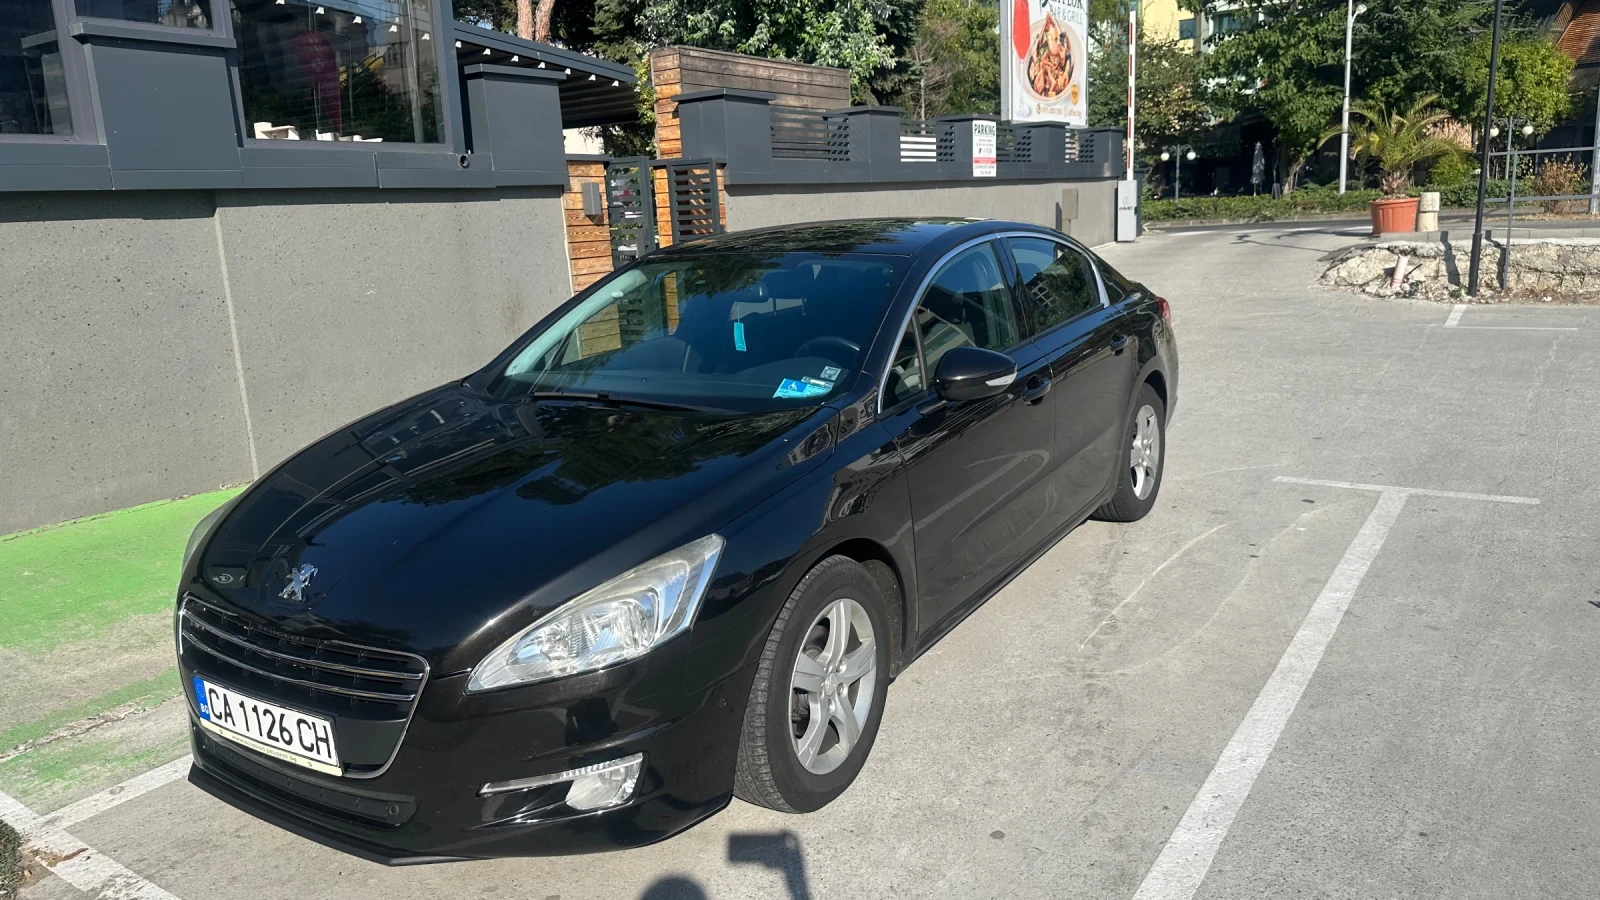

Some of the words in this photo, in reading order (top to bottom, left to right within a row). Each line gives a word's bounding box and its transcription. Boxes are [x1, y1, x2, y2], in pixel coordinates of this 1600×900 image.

[974, 123, 995, 136] PARKING
[200, 703, 209, 714] BG
[208, 687, 236, 726] CA
[239, 700, 293, 746] 1126
[296, 718, 332, 758] CH
